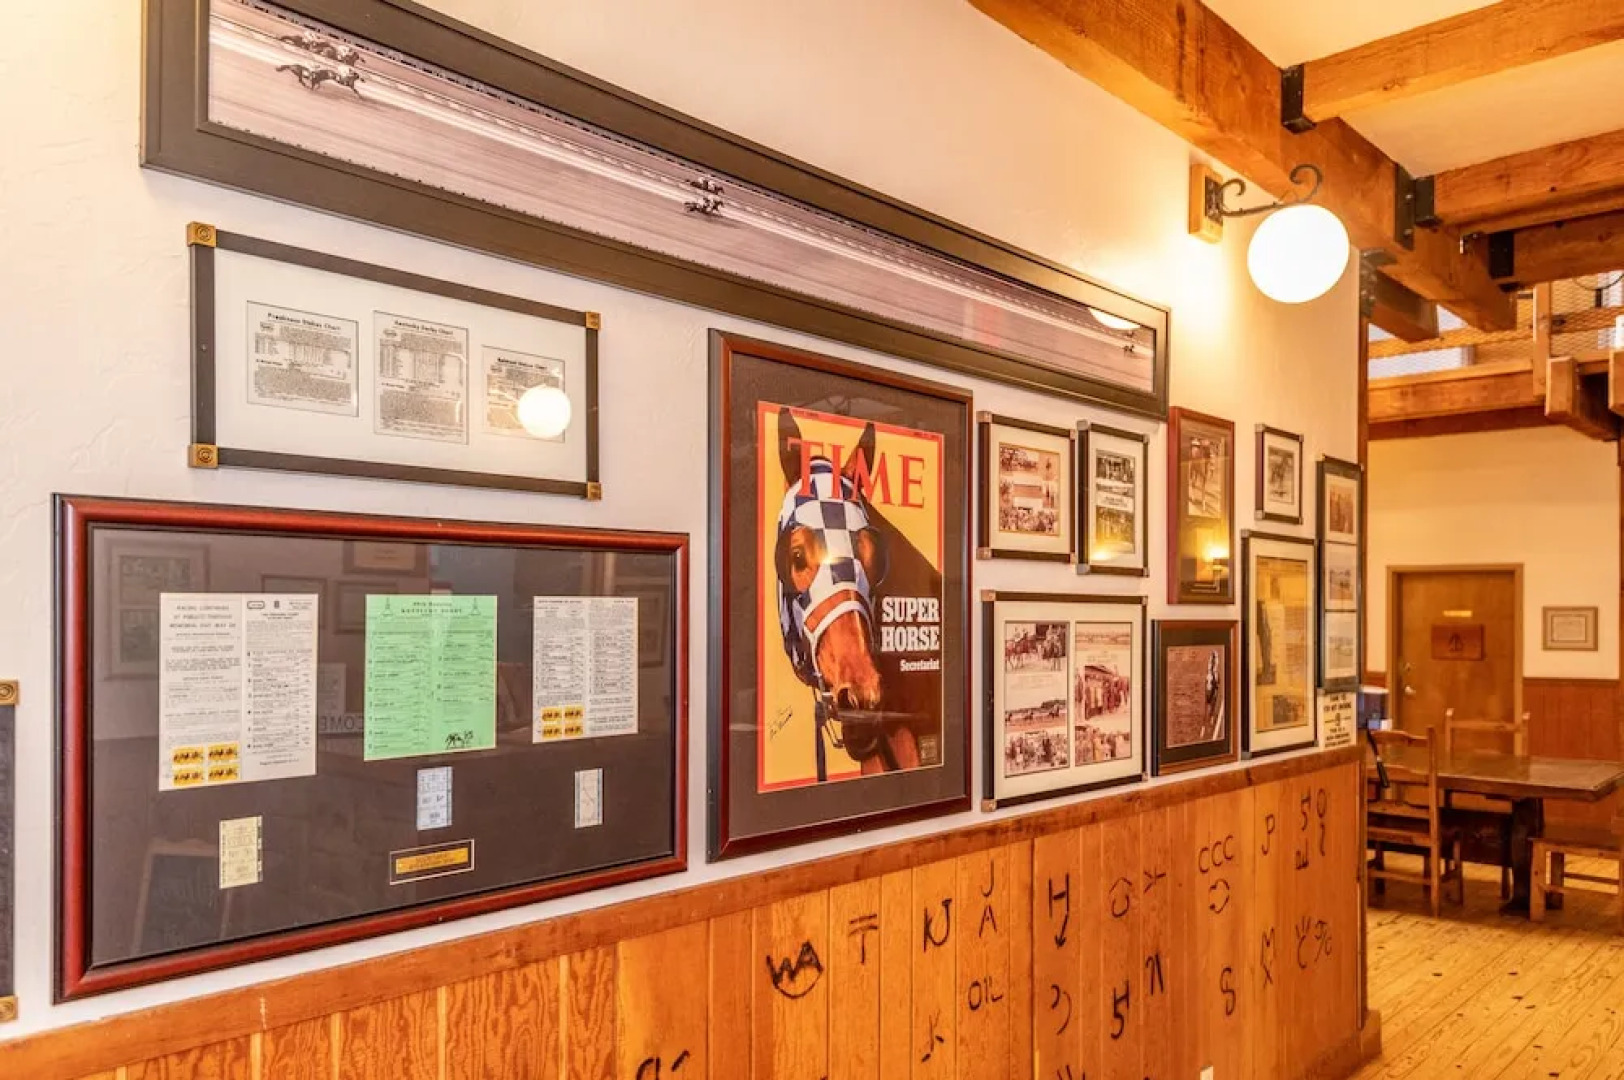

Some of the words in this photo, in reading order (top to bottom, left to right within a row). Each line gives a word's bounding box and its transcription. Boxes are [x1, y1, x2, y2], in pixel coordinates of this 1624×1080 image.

[787, 437, 926, 510] TIME
[881, 596, 940, 623] SUPER
[881, 624, 940, 652] HORSE
[900, 658, 940, 672] Secretariat
[1198, 834, 1234, 874] CCC
[766, 940, 824, 989] WA
